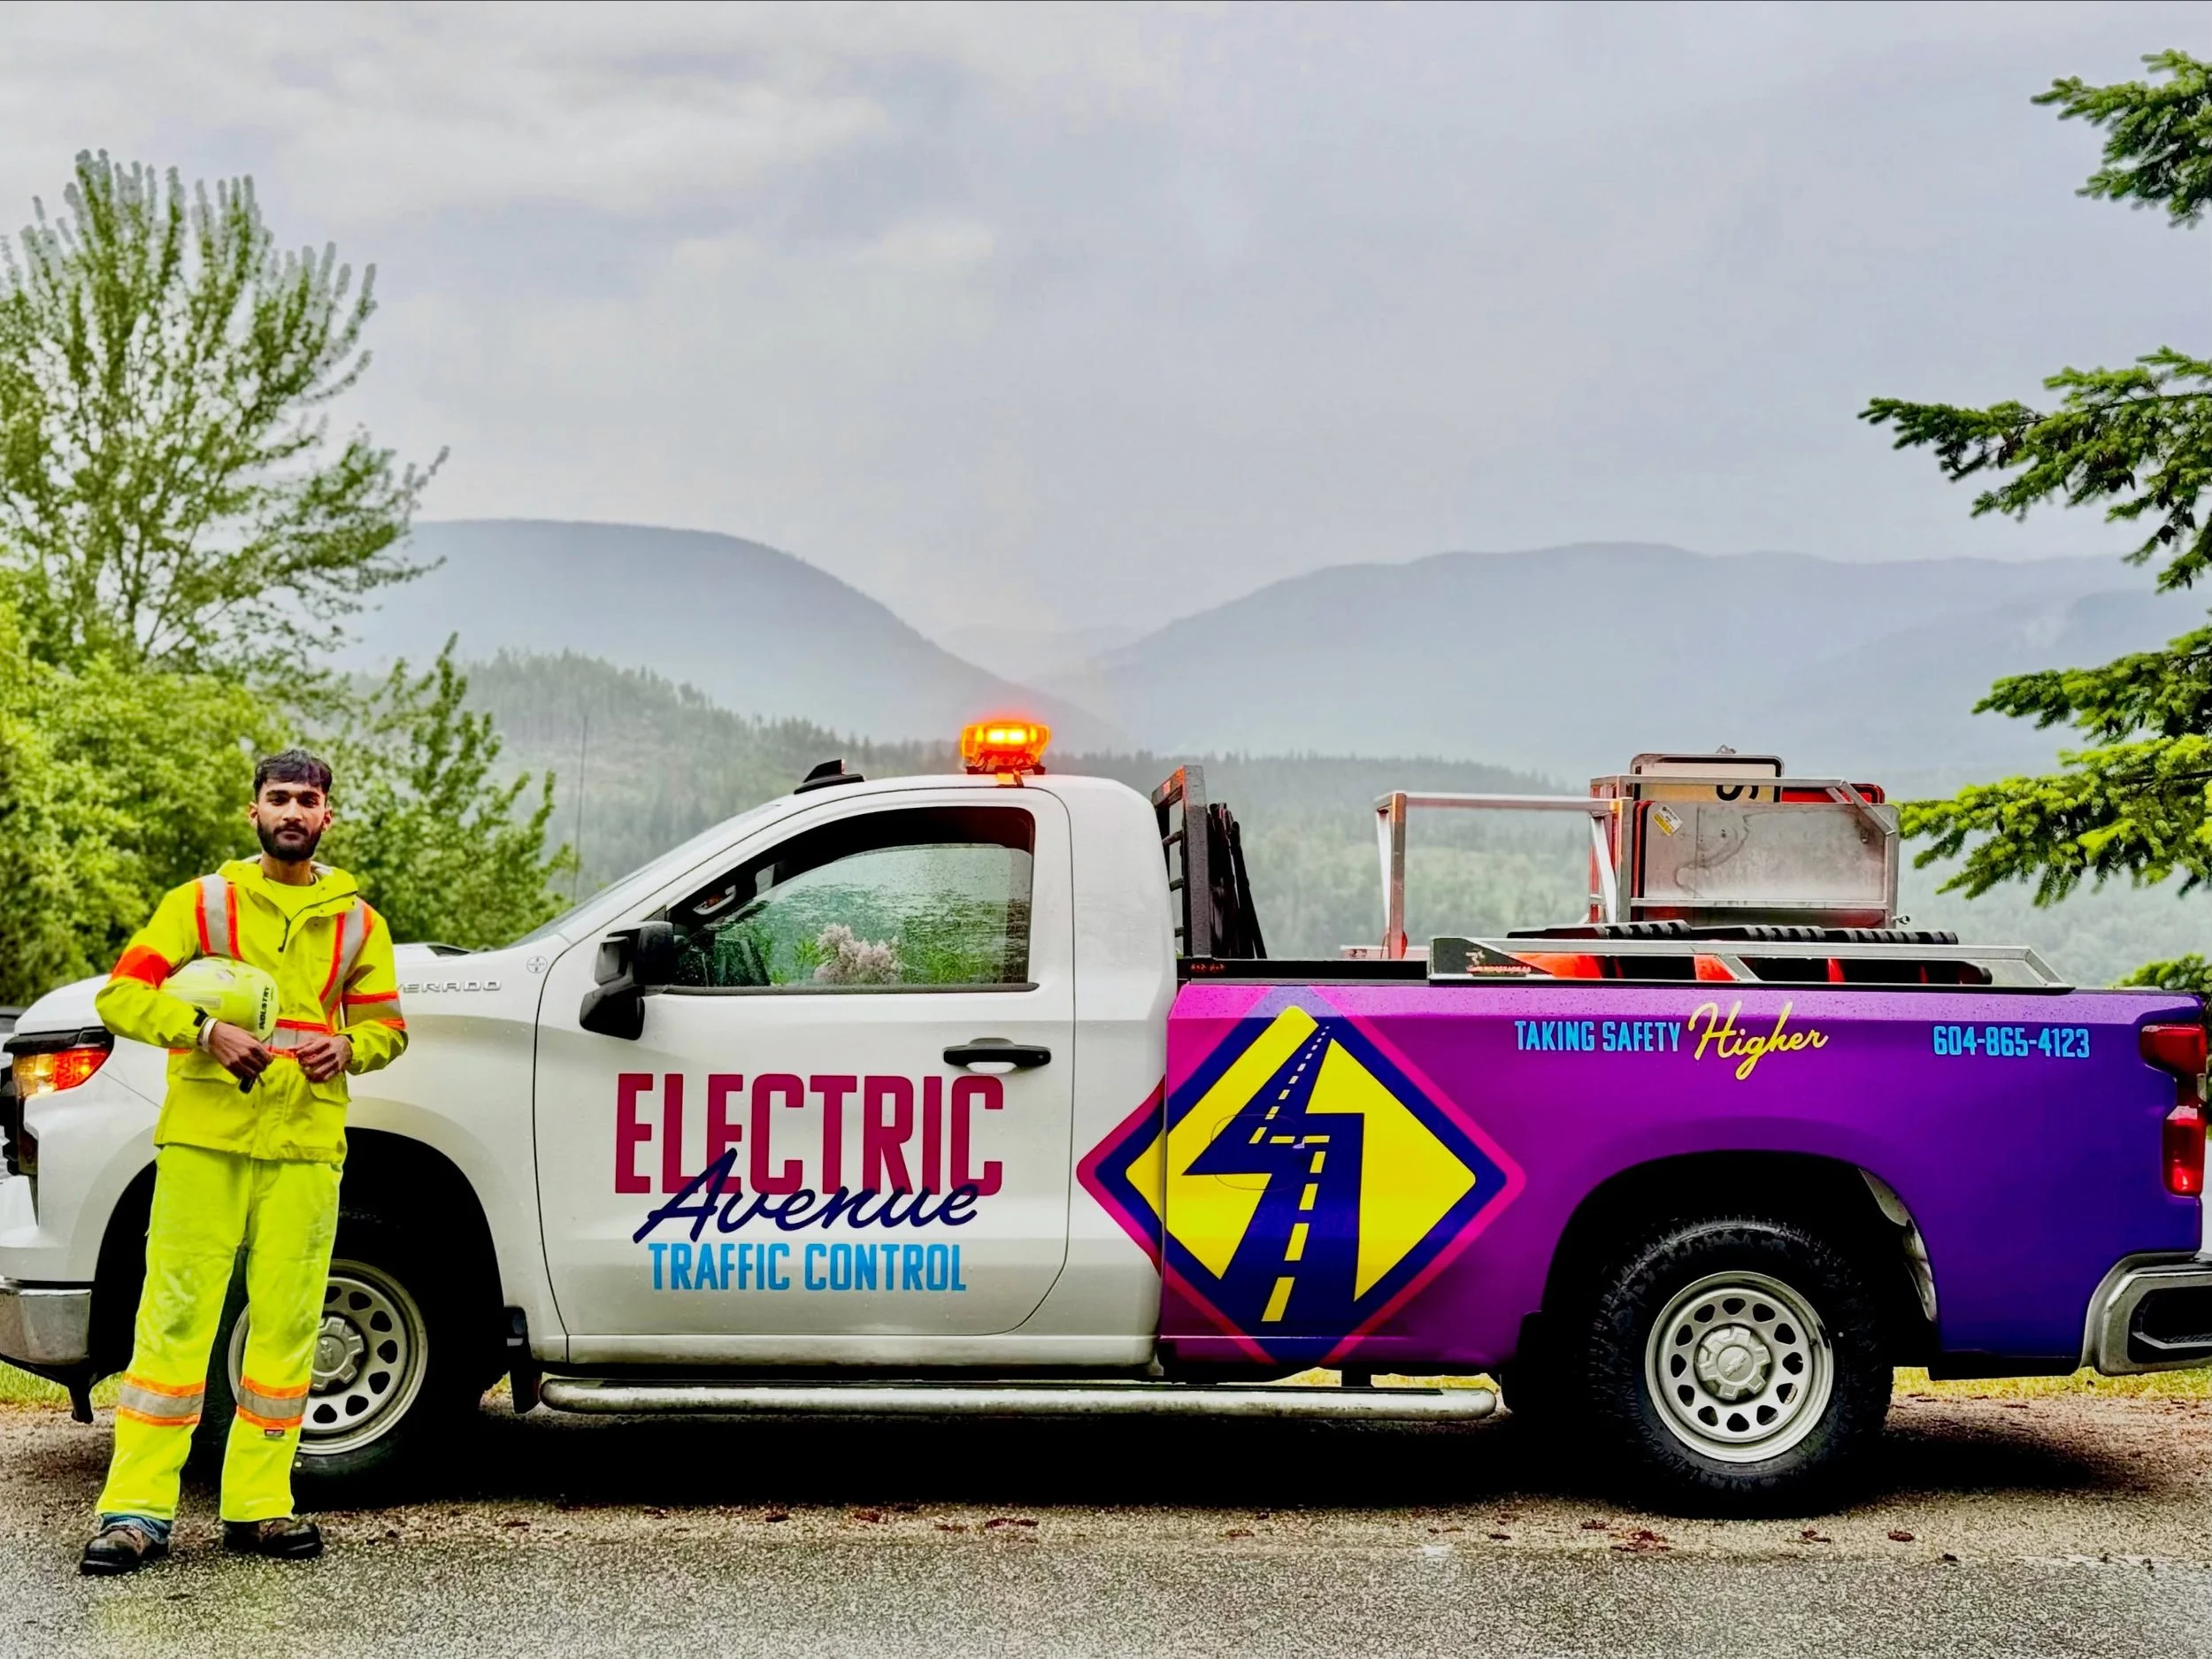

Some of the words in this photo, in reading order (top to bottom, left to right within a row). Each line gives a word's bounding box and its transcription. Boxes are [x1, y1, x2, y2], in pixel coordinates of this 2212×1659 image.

[1515, 1020, 1594, 1051] TAKING
[1602, 1021, 1680, 1052] SAFETY
[1688, 1000, 1828, 1080] Higher
[1933, 1025, 2090, 1058] 604-865-4123
[615, 1073, 1003, 1196] ELECTRIC
[632, 1148, 979, 1243] Avenue
[648, 1242, 790, 1291] TRAFFIC
[804, 1243, 966, 1292] CONTROL
